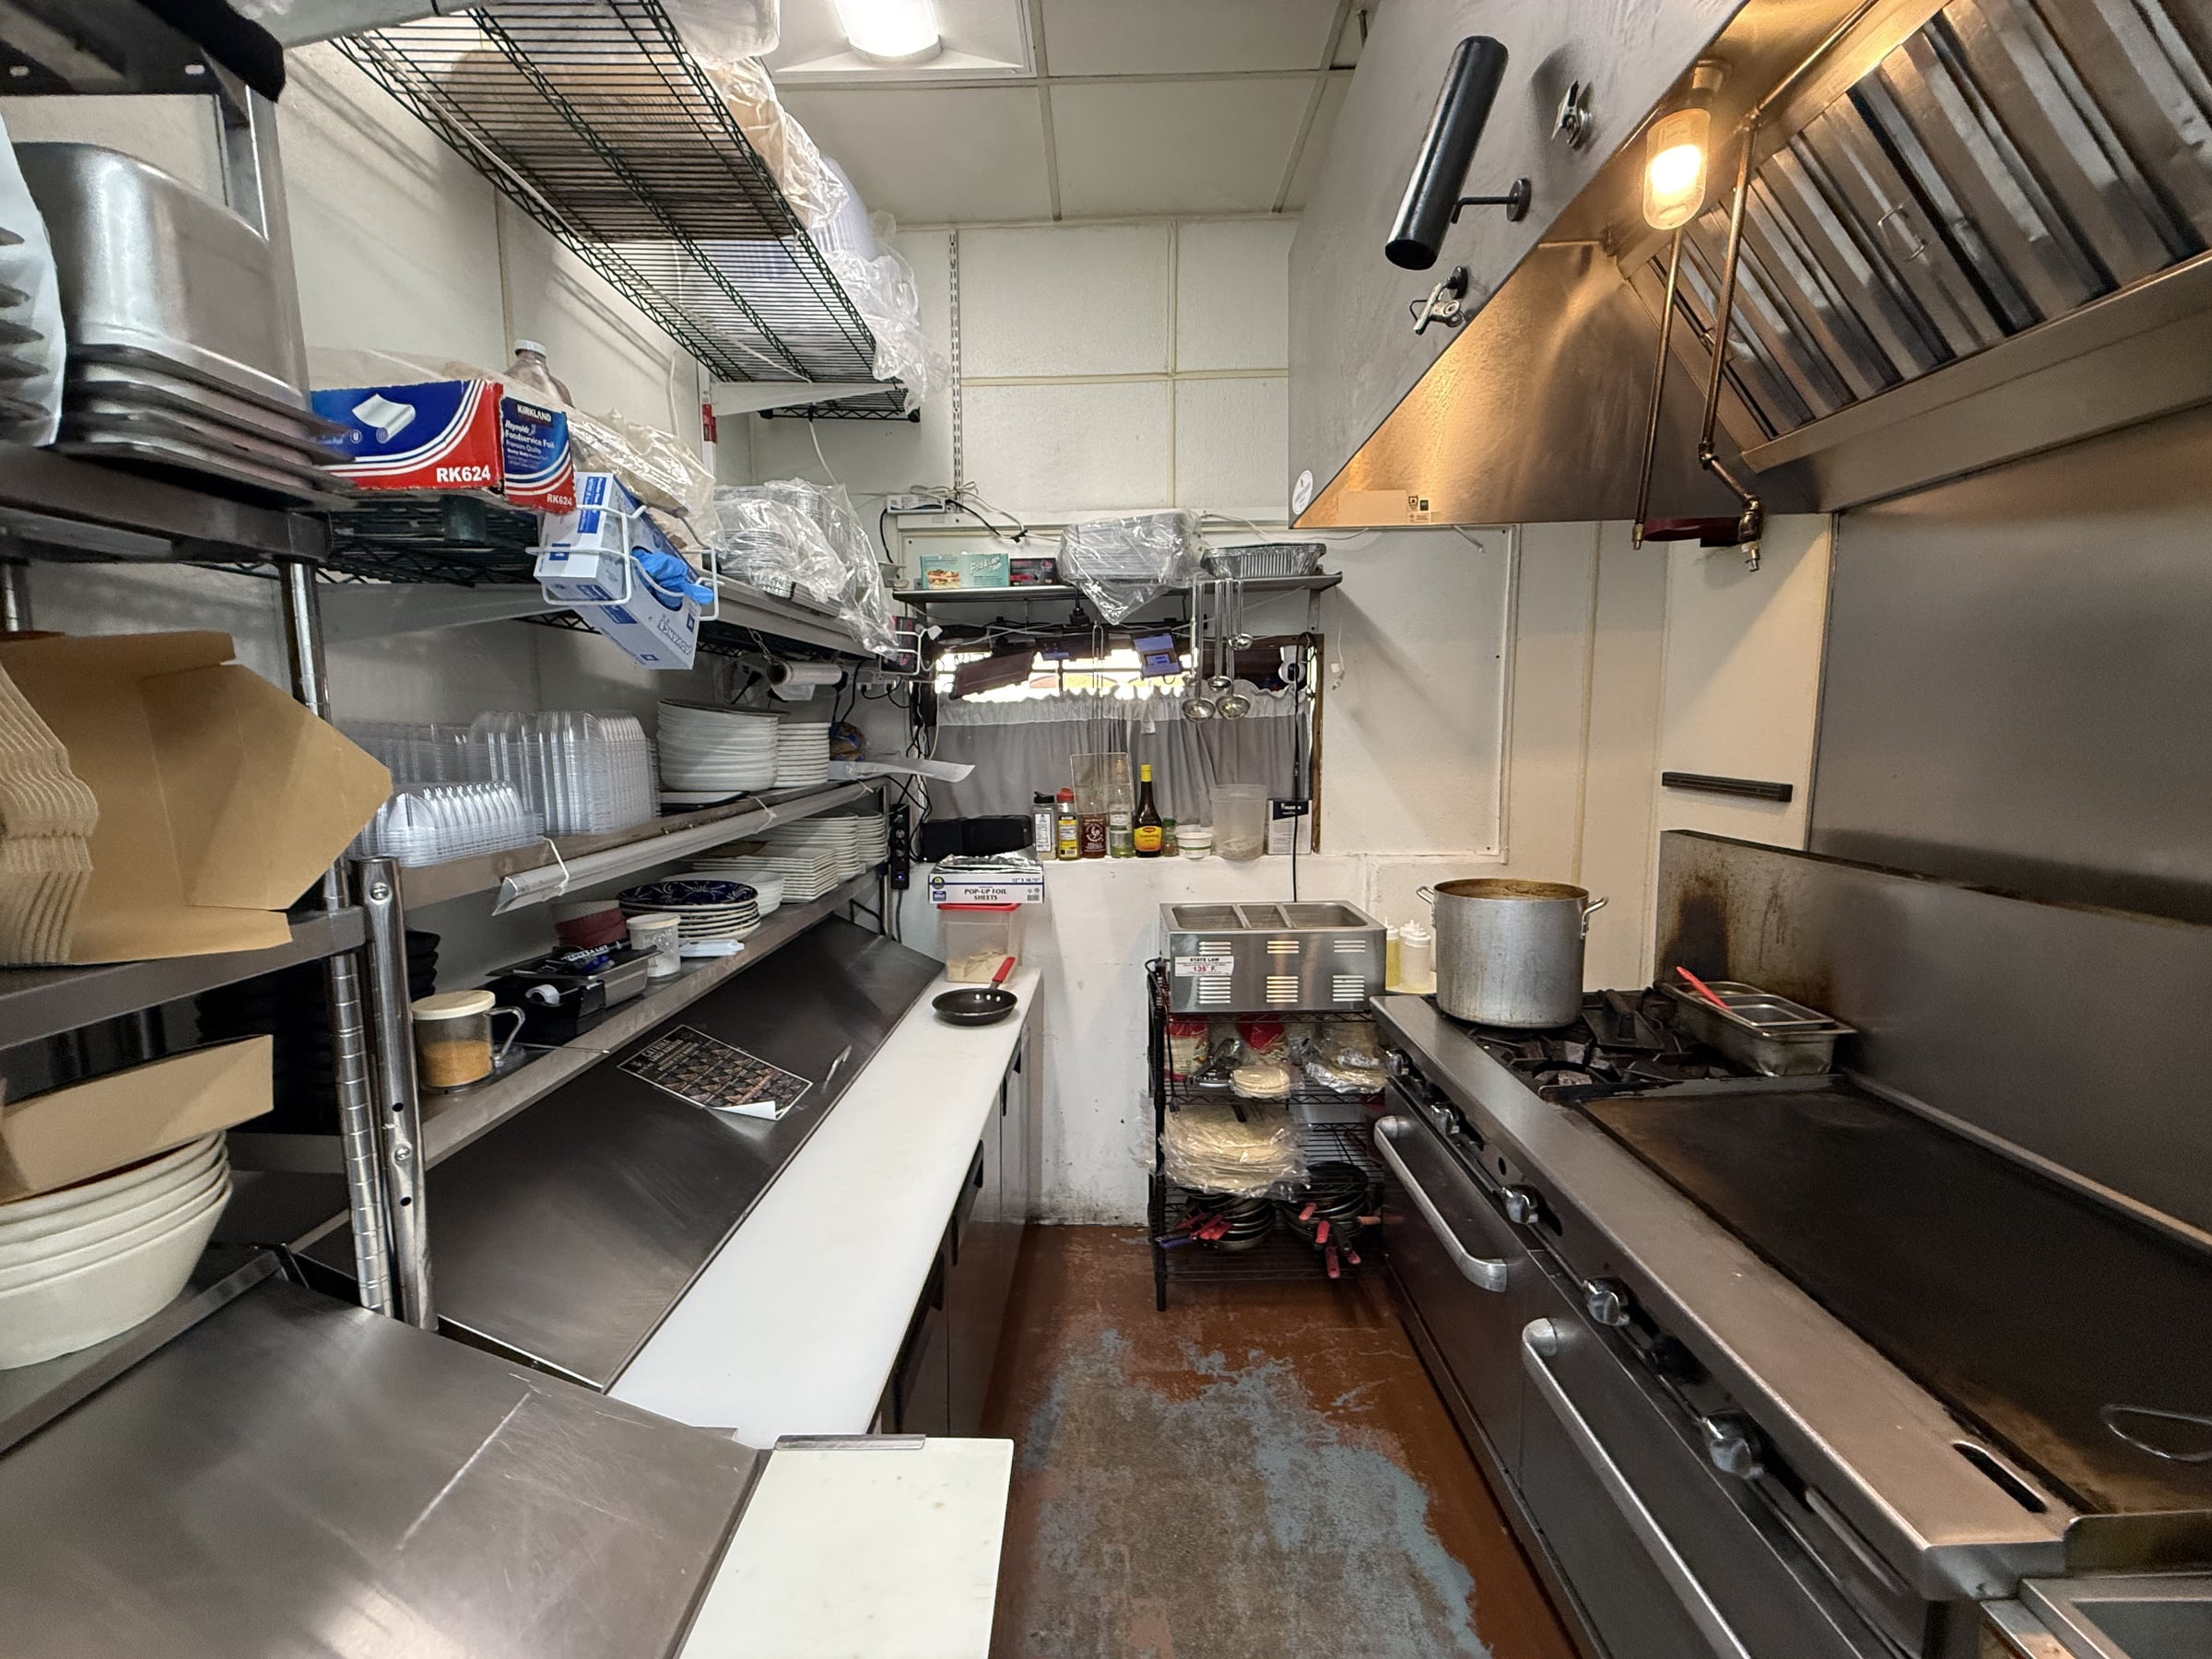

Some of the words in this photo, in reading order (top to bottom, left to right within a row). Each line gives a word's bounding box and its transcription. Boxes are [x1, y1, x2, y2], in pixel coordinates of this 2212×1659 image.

[517, 404, 552, 422] KIRKLAND
[505, 419, 530, 434] Reynolds
[505, 429, 542, 447] Foodservice
[542, 439, 555, 449] Foil
[506, 439, 525, 450] Premium
[526, 444, 541, 454] Quality
[436, 465, 491, 483] RK624
[547, 493, 572, 506] RK624
[657, 618, 694, 655] ADVANCE
